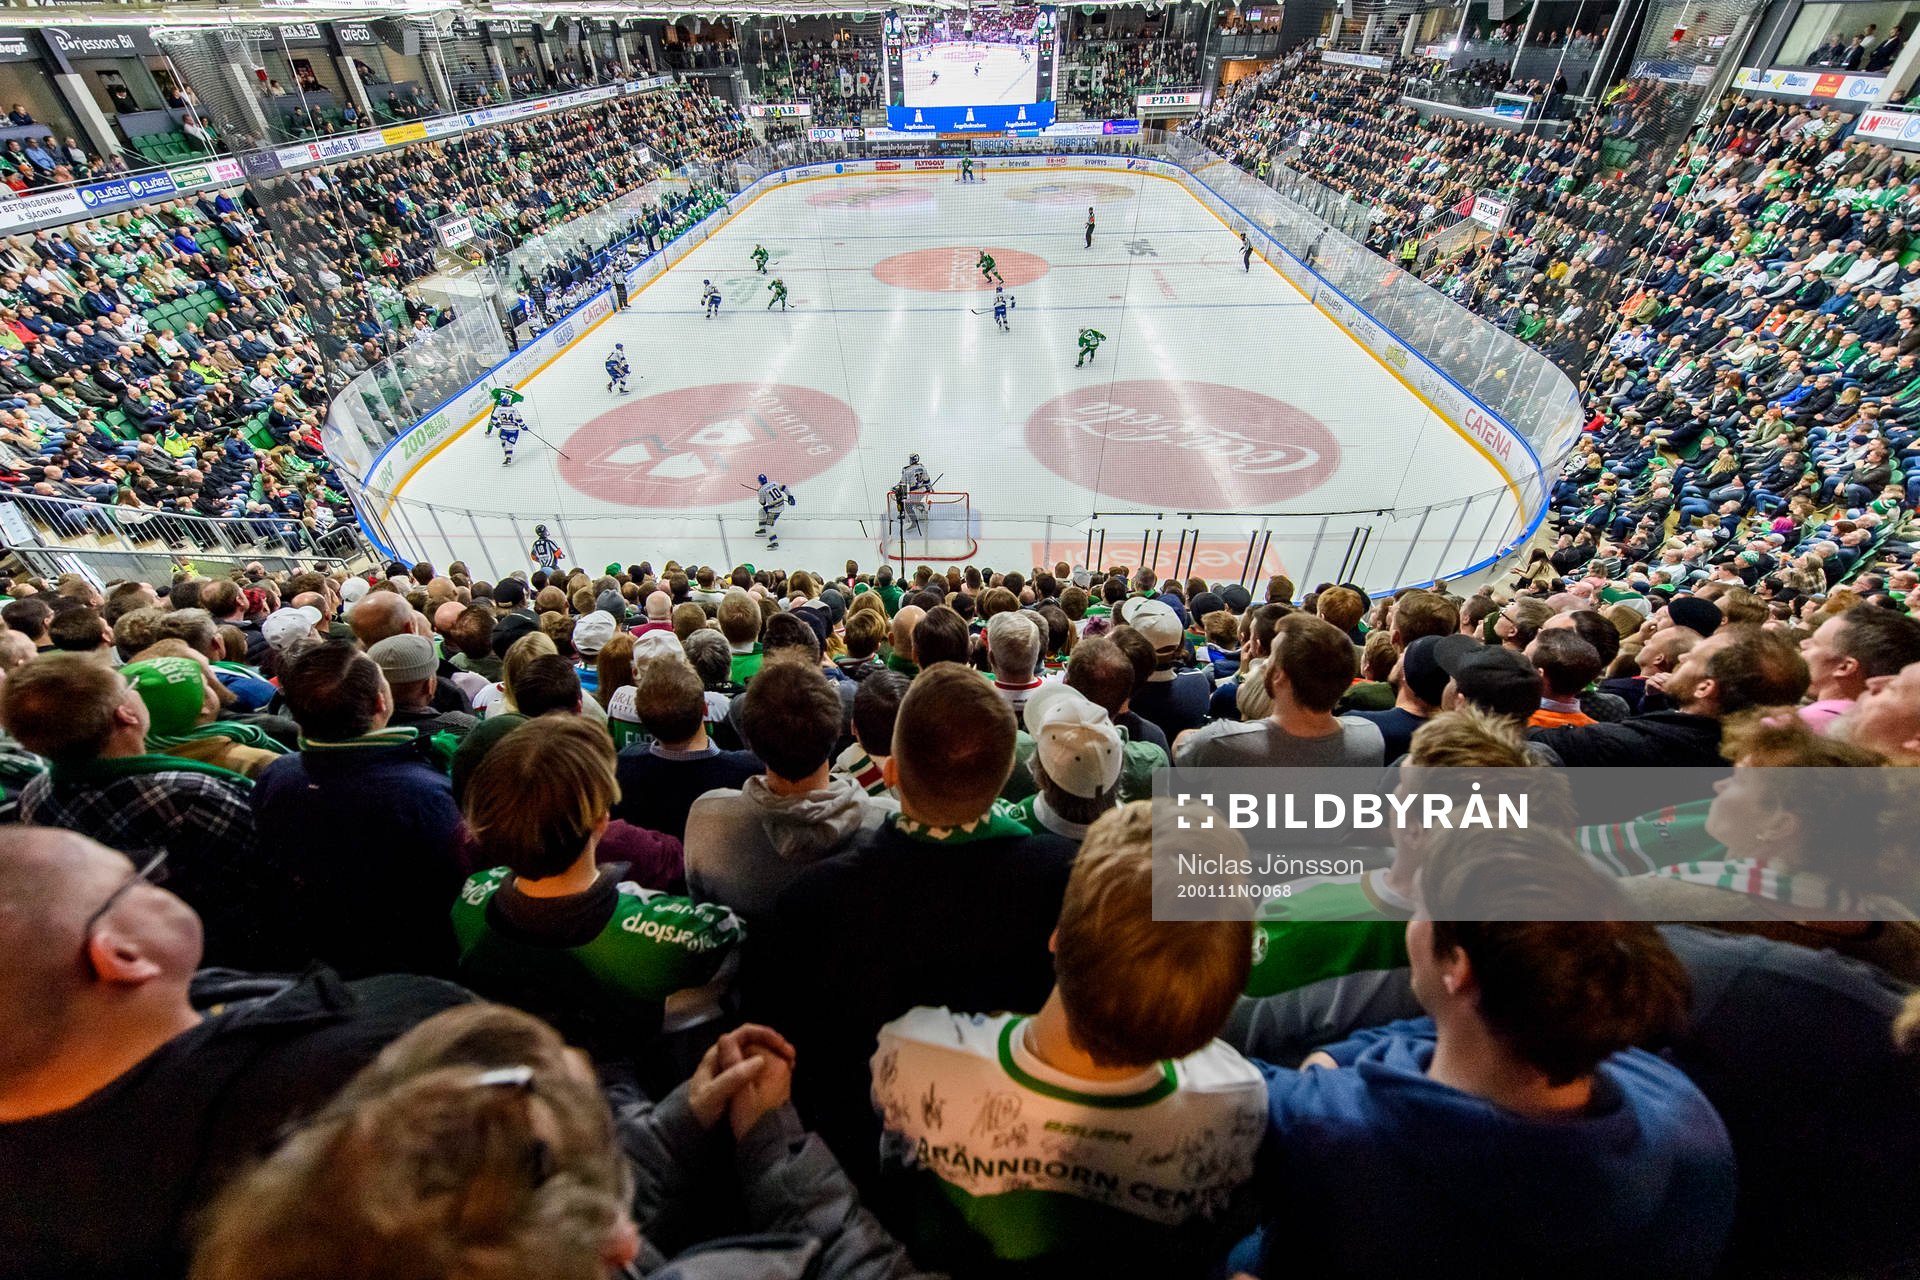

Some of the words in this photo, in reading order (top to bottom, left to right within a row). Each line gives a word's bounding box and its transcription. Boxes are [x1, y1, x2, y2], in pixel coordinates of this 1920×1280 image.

[341, 28, 370, 41] areco
[1150, 95, 1186, 105] PEAB
[1859, 115, 1881, 132] LM
[813, 129, 836, 139] BDO
[318, 142, 350, 158] Lindells
[348, 137, 361, 151] Bil
[2, 191, 76, 213] BETONGBORRNING
[582, 296, 611, 326] CATENA
[400, 427, 428, 461] 200
[1464, 407, 1512, 462] CATENA
[768, 487, 783, 502] 10
